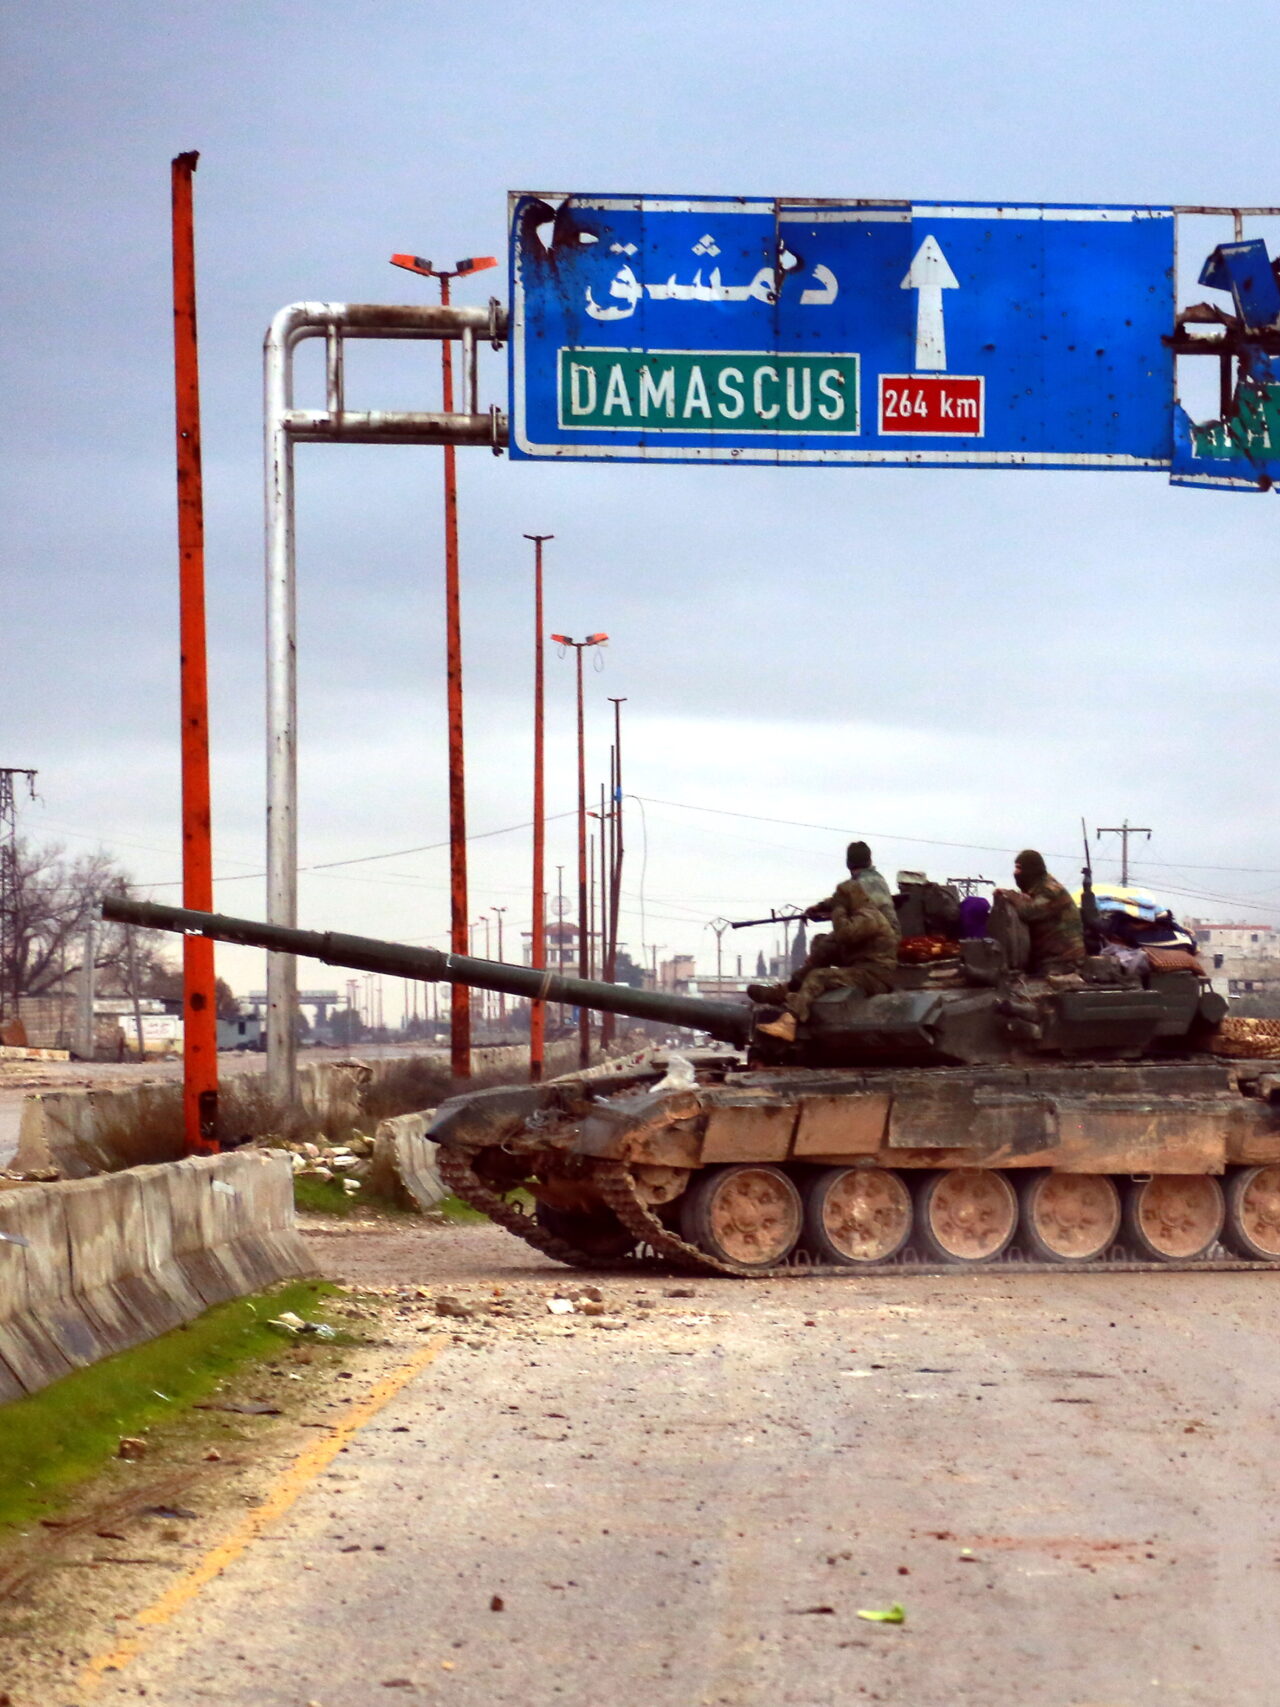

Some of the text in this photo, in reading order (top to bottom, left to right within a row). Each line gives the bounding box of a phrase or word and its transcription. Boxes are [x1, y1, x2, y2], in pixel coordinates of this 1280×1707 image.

[585, 234, 839, 321] دمشق
[570, 359, 846, 421] DAMASCUS
[884, 389, 978, 419] 264 km
